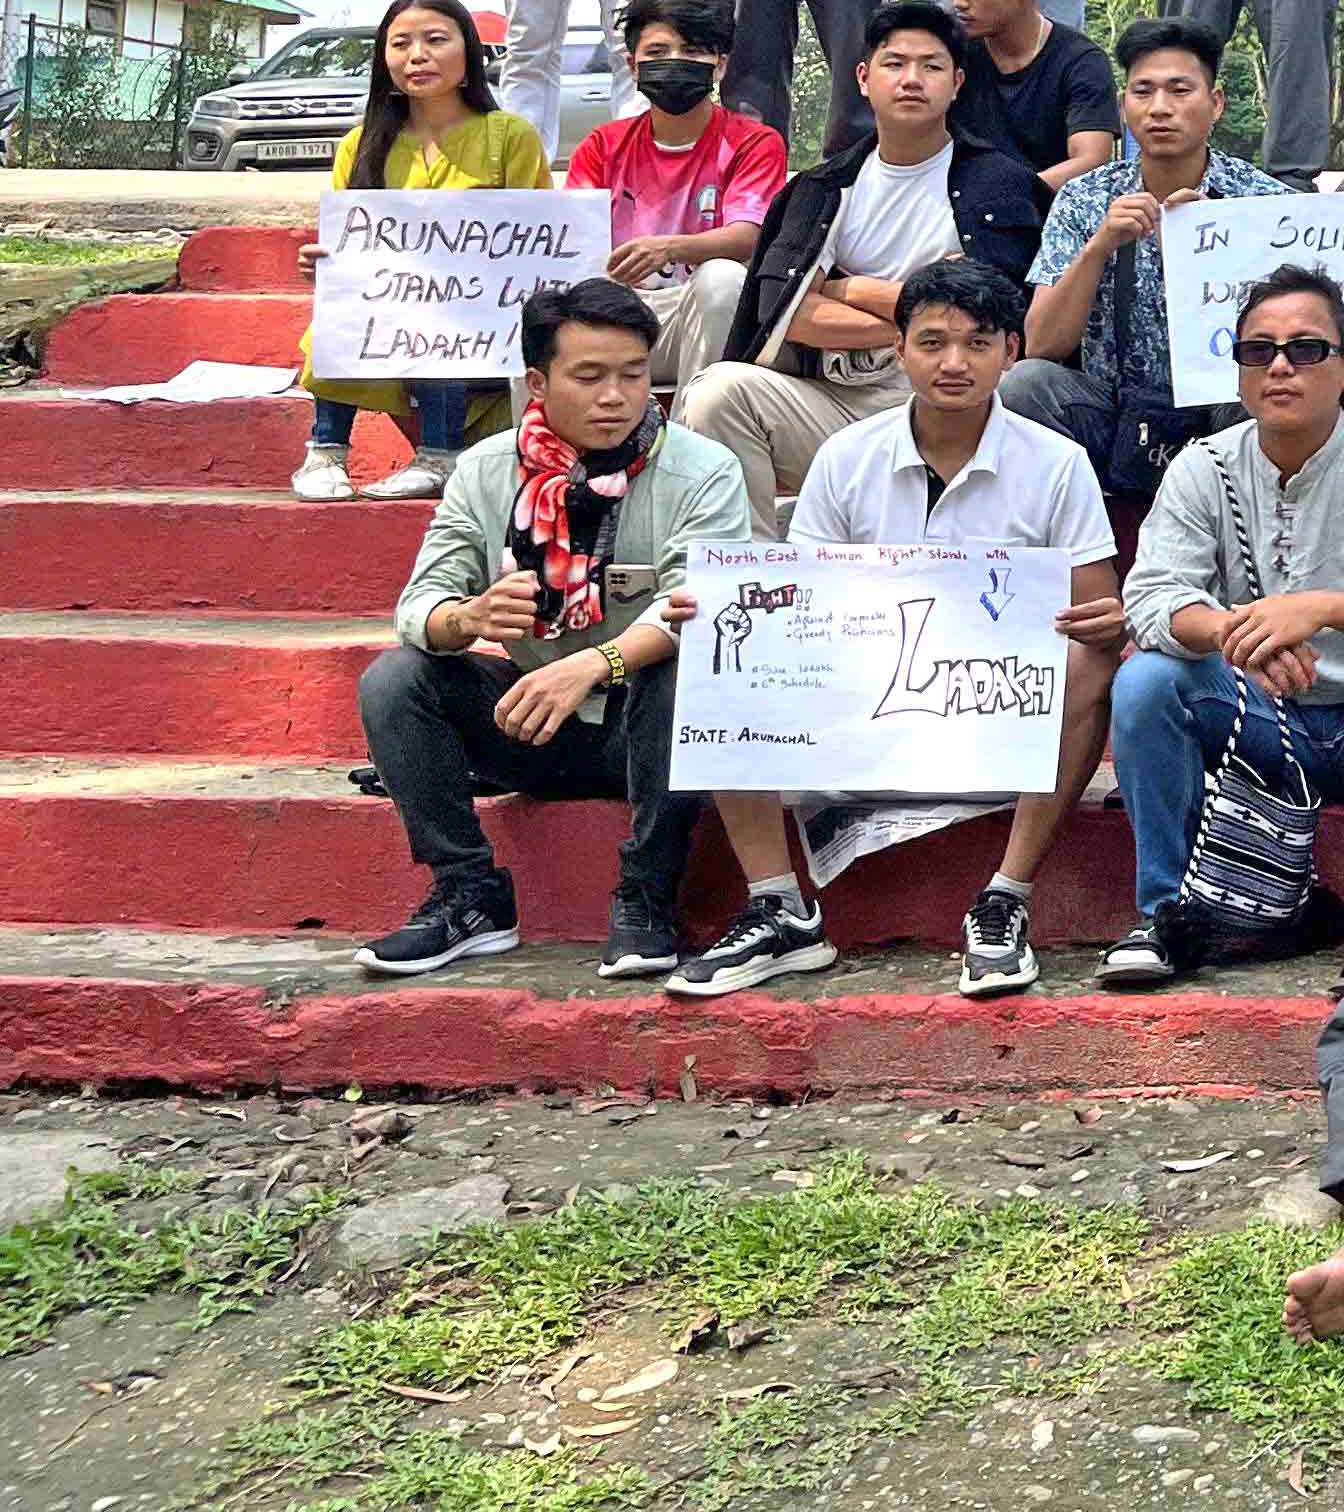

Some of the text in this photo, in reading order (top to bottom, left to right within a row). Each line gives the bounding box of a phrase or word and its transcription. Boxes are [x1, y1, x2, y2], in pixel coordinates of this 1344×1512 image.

[336, 206, 581, 260] ARUNACHAL
[1193, 221, 1230, 254] IN
[362, 268, 484, 304] STANDS
[764, 548, 800, 563] East
[983, 546, 1010, 561] with
[872, 597, 1056, 720] LADAKH
[738, 727, 818, 746] ARUNACHAL
